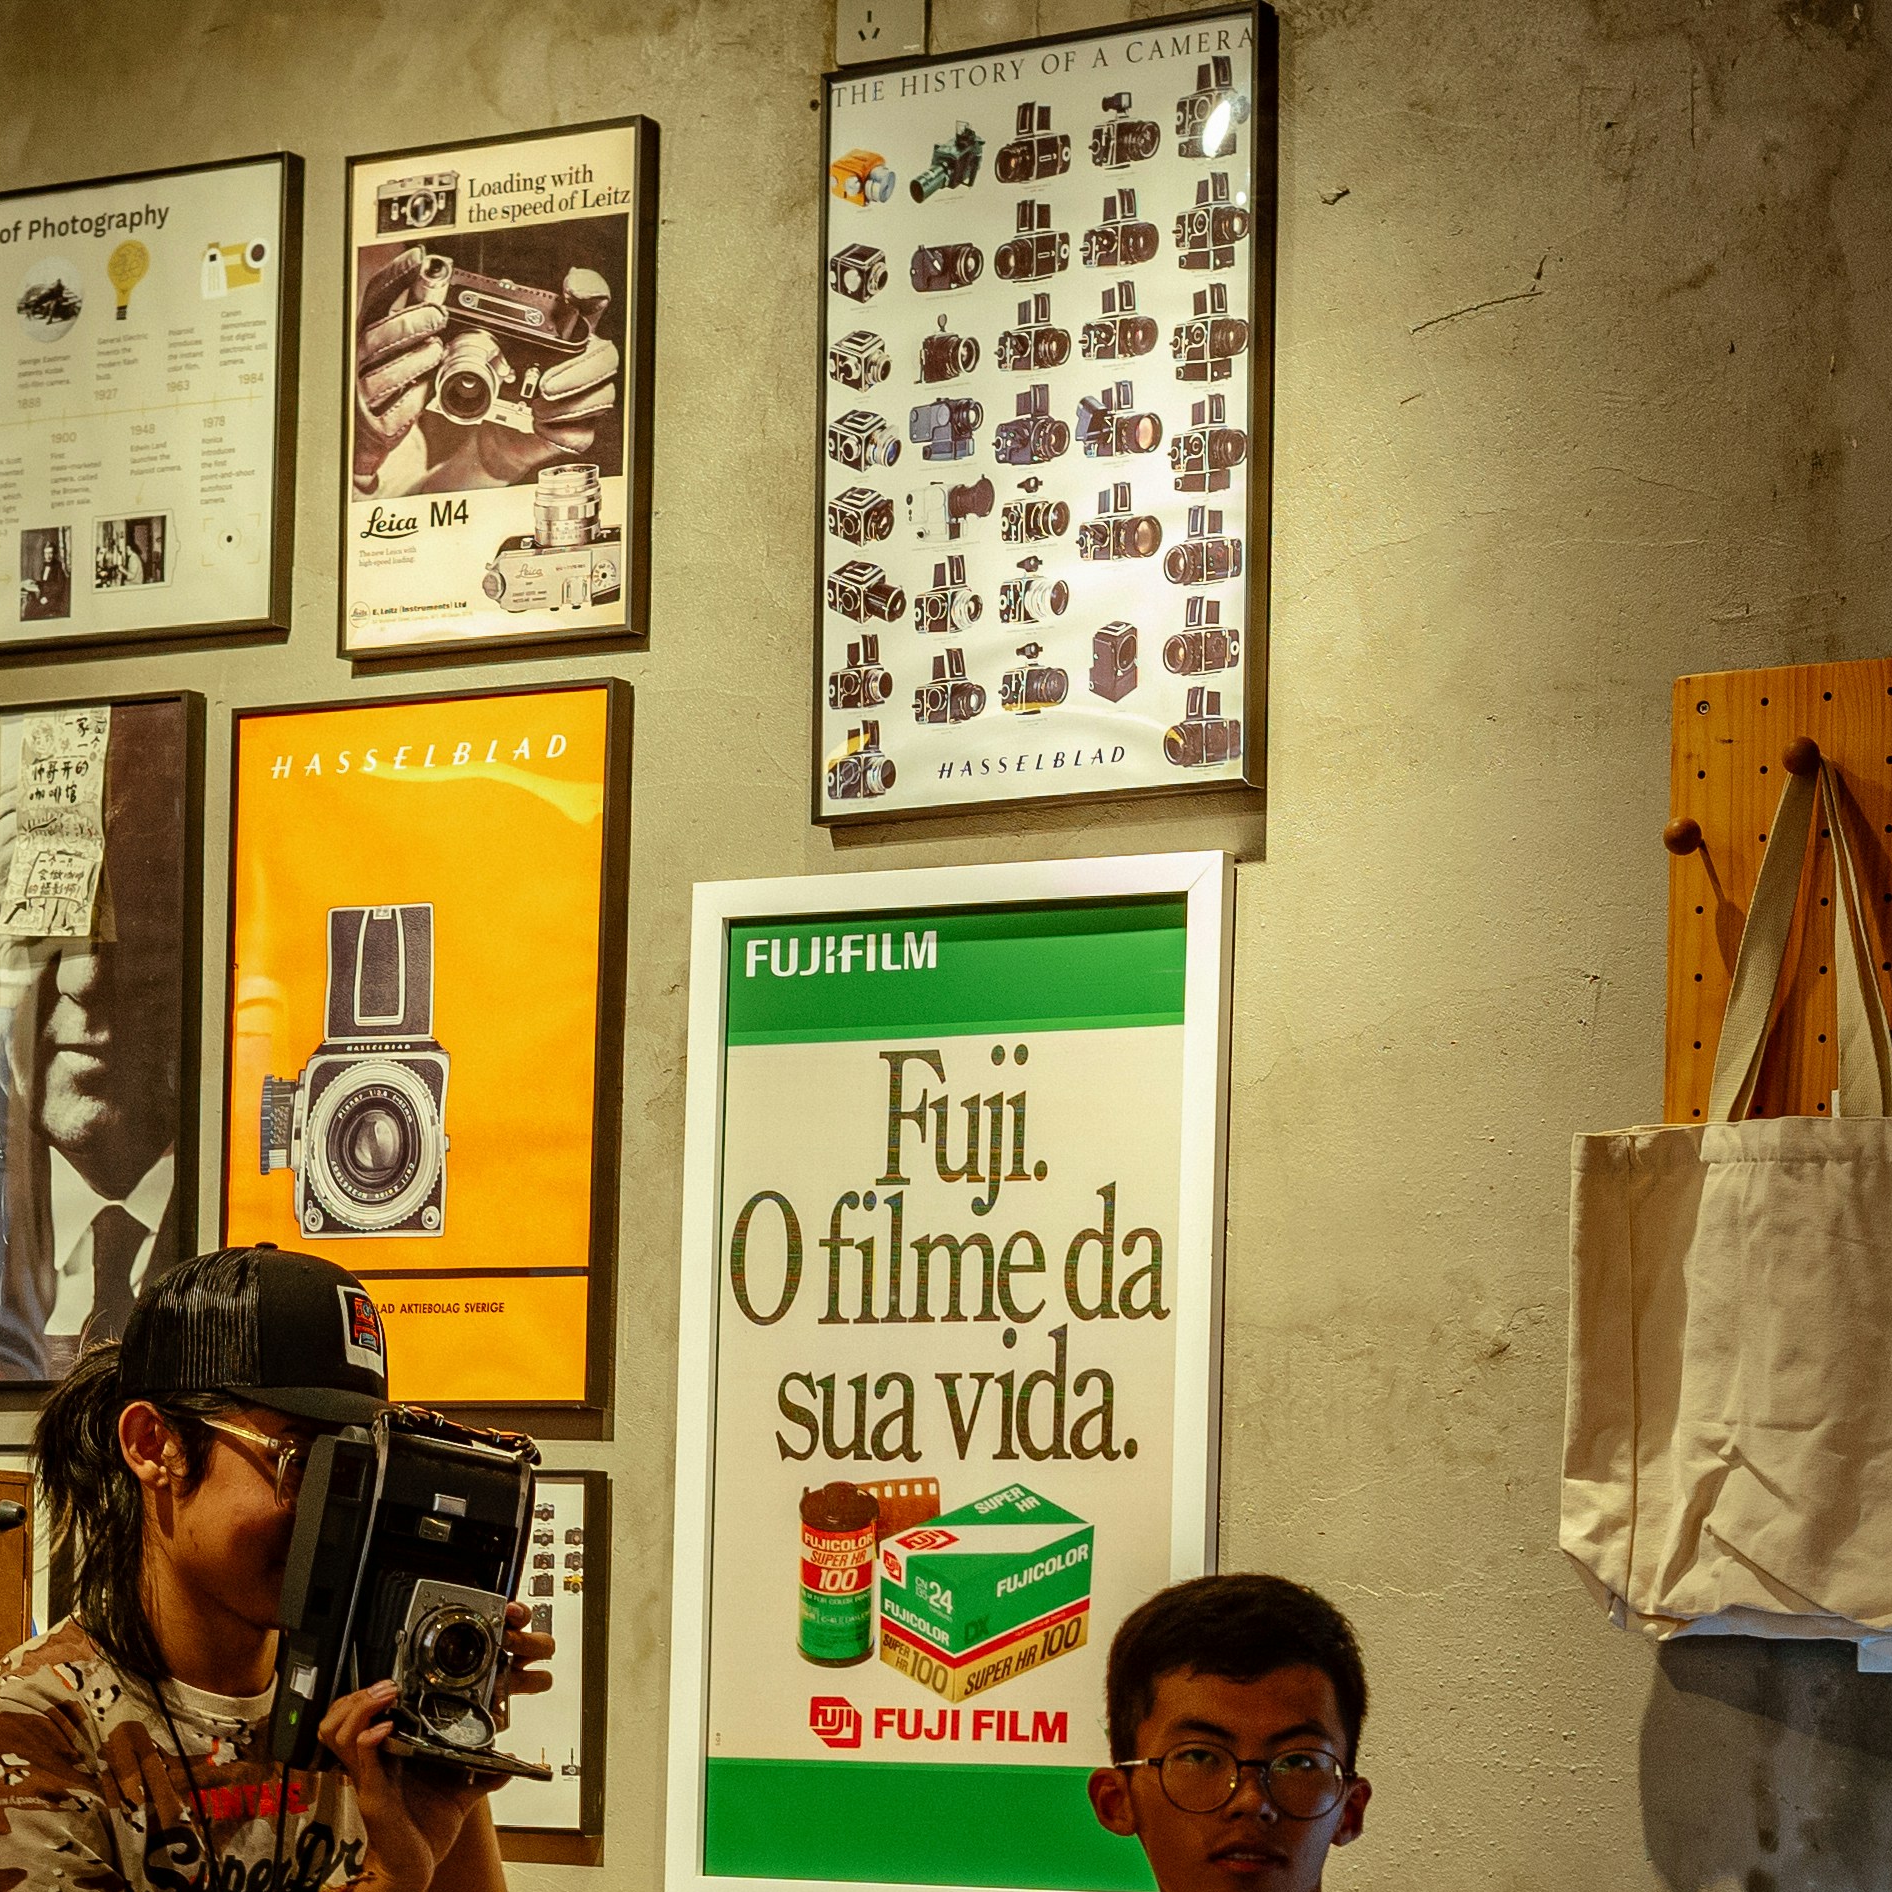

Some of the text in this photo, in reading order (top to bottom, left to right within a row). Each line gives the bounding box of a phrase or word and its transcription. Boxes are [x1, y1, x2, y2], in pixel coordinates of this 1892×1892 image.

[831, 25, 1253, 108] THE HISTORY OF A CAMERA
[468, 164, 594, 198] Loading with
[468, 185, 631, 223] the speed of Leitz
[0, 220, 22, 244] of
[27, 203, 170, 242] Photography
[166, 380, 190, 393] 1963
[238, 372, 264, 385] 1984
[51, 431, 77, 444] 1900
[130, 423, 156, 436] 1948
[202, 415, 226, 428] 1978
[359, 498, 470, 540] Leica M4
[515, 563, 544, 579] Leica
[271, 731, 569, 781] HASSELBLAD
[936, 744, 1127, 780] HASSELBLAD
[745, 930, 938, 979] FUJIFILM
[875, 1043, 1049, 1217] Fuji.
[730, 1180, 1170, 1326] O filme da
[399, 1301, 505, 1315] AKTIEBOLAG SVERIGE
[775, 1323, 1138, 1464] sua vida.
[973, 1486, 1026, 1515] SUPER
[1014, 1495, 1042, 1513] HR
[803, 1532, 874, 1552] FUJICOLOR
[811, 1550, 849, 1568] SUPER
[818, 1567, 859, 1592] 100
[995, 1543, 1089, 1598] FUJICOLOR
[928, 1578, 954, 1616] 24
[884, 1597, 951, 1648] FUJICOLOR
[964, 1614, 990, 1646] DX
[882, 1633, 911, 1660] SUPER
[963, 1655, 1013, 1697] SUPER
[1013, 1643, 1039, 1672] HR
[1039, 1616, 1083, 1662] 100
[895, 1650, 950, 1696] HR 100
[873, 1707, 961, 1742] FUJI
[971, 1709, 1069, 1744] FILM
